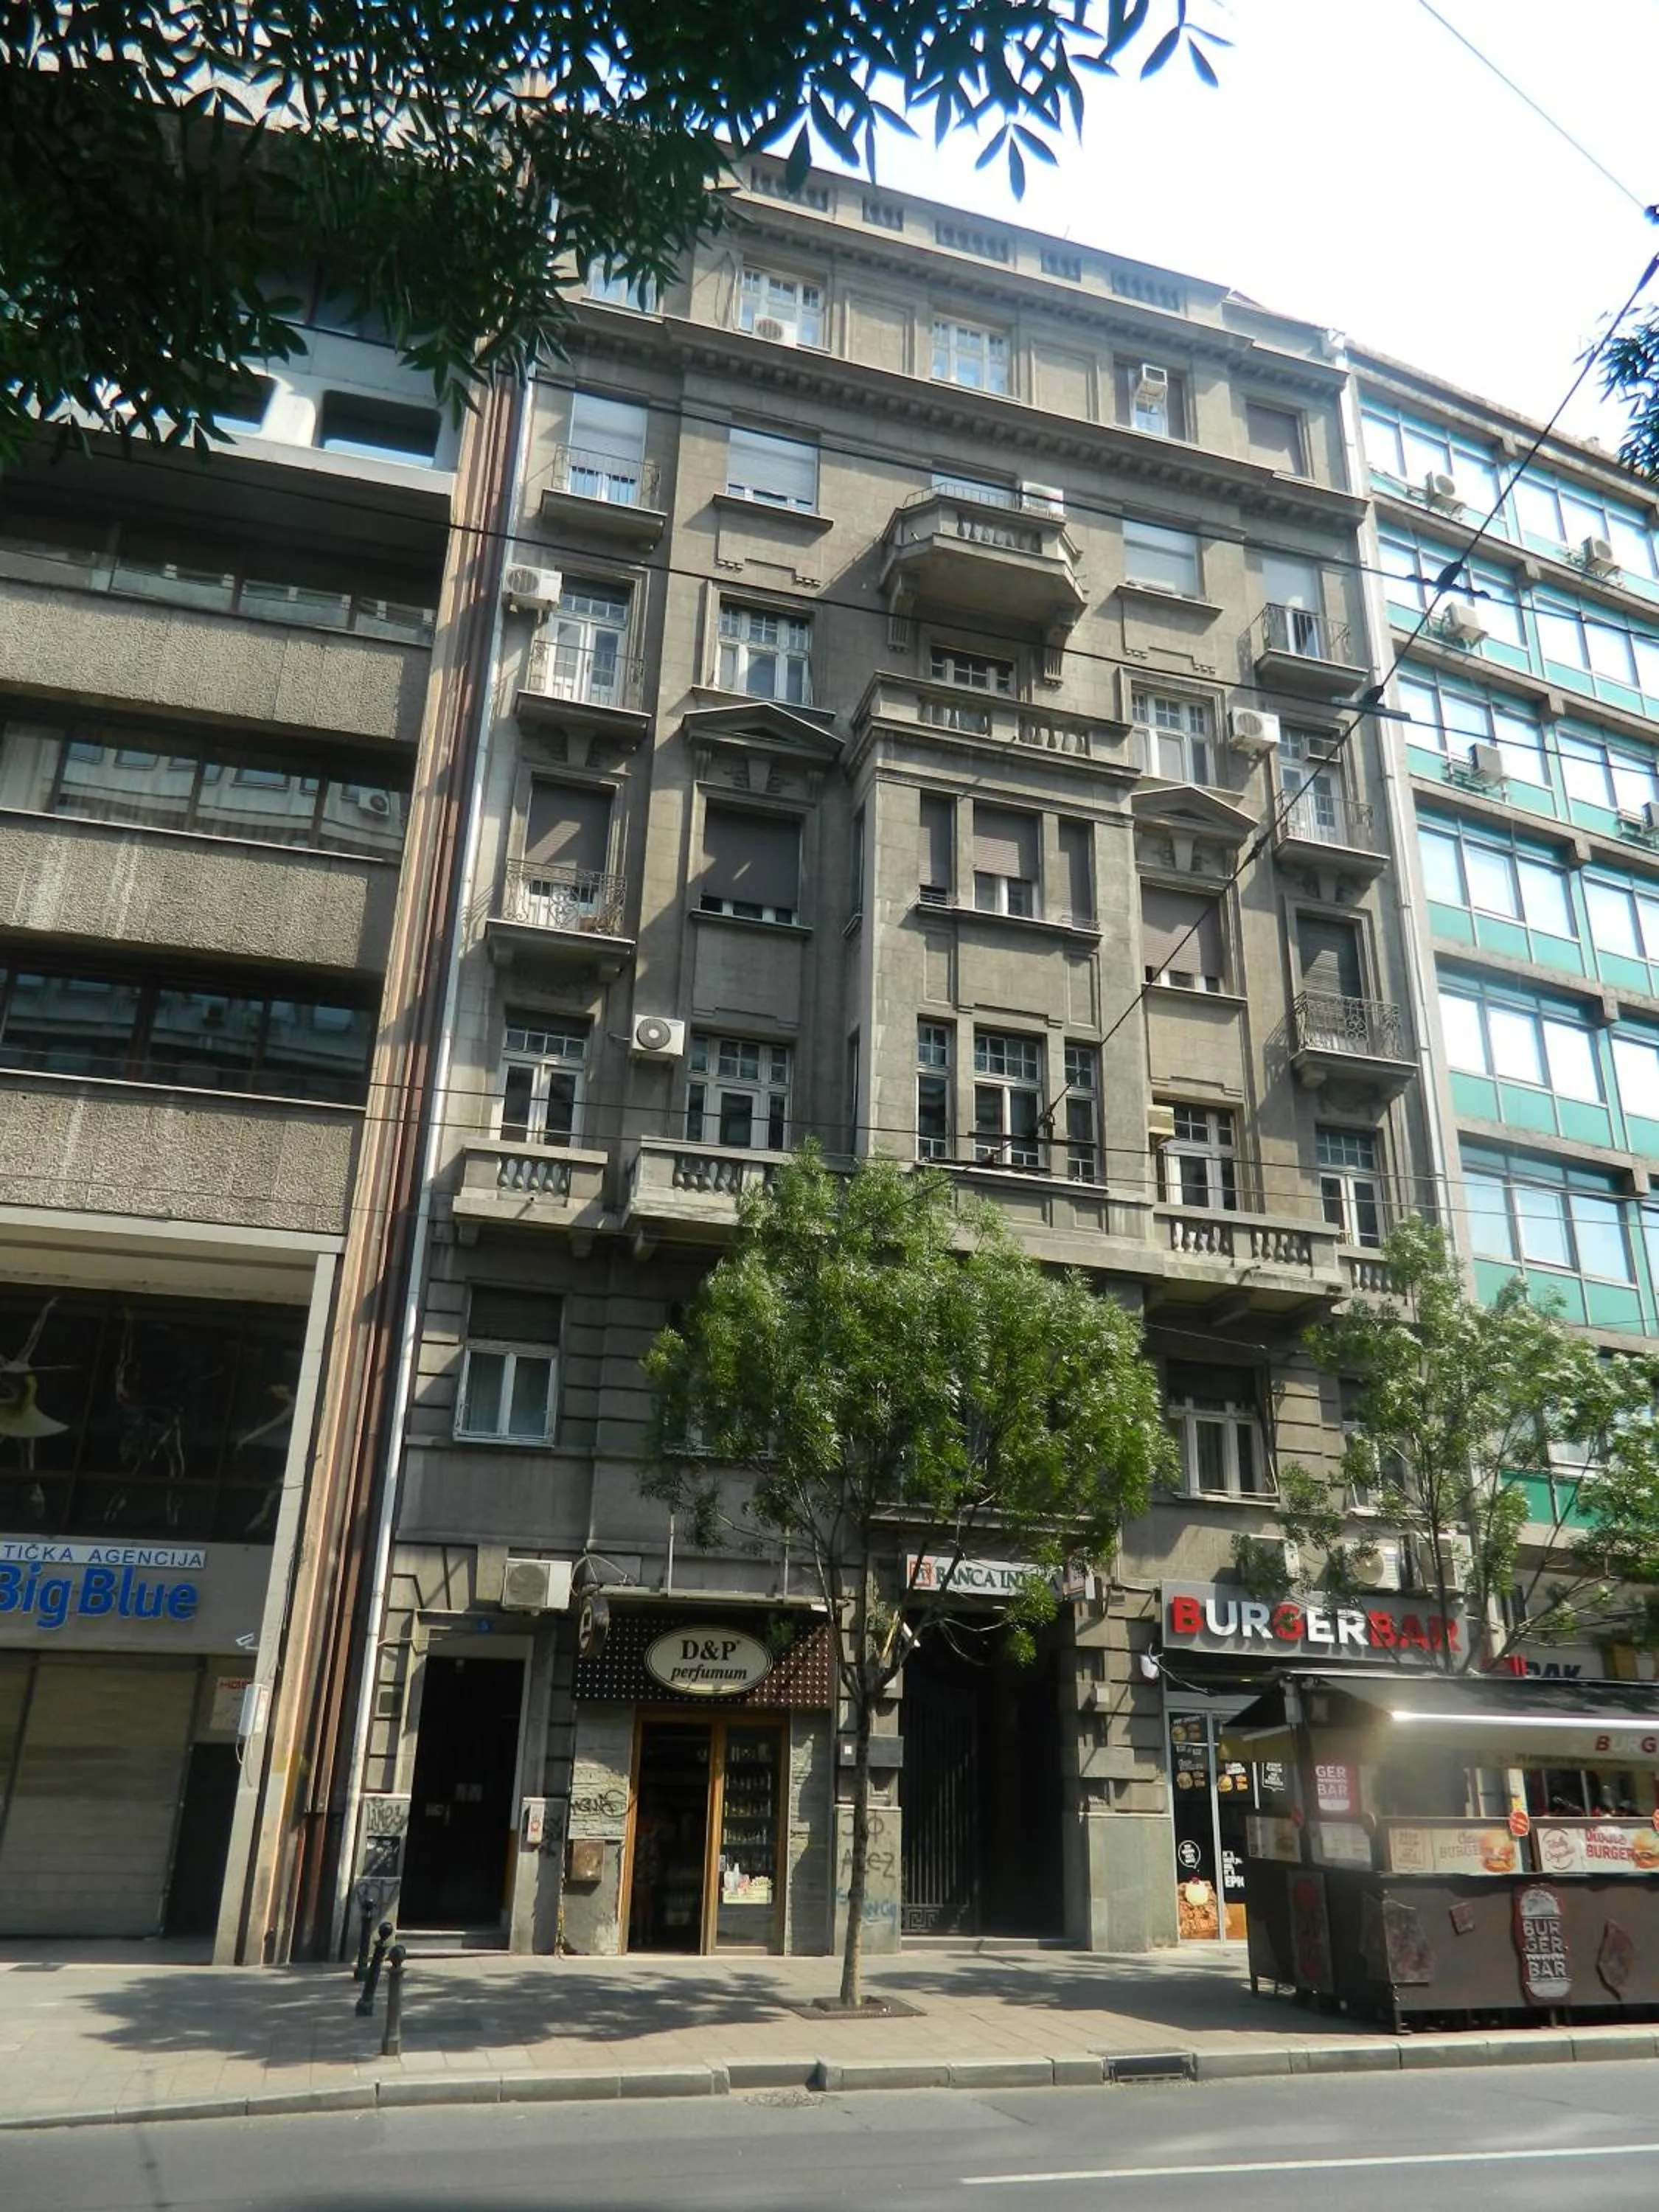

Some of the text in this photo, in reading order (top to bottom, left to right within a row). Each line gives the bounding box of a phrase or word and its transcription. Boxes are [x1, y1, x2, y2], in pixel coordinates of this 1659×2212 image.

[88, 1548, 202, 1567] AGENCIJA
[0, 1561, 198, 1630] Big Blue
[681, 1639, 737, 1661] D&P
[670, 1664, 748, 1682] perfumum
[1315, 1764, 1346, 1778] GER
[1318, 1784, 1348, 1796] BAR
[1523, 1919, 1560, 1937] BUR
[1524, 1936, 1563, 1954] GER
[1528, 1961, 1567, 1978] BAR
